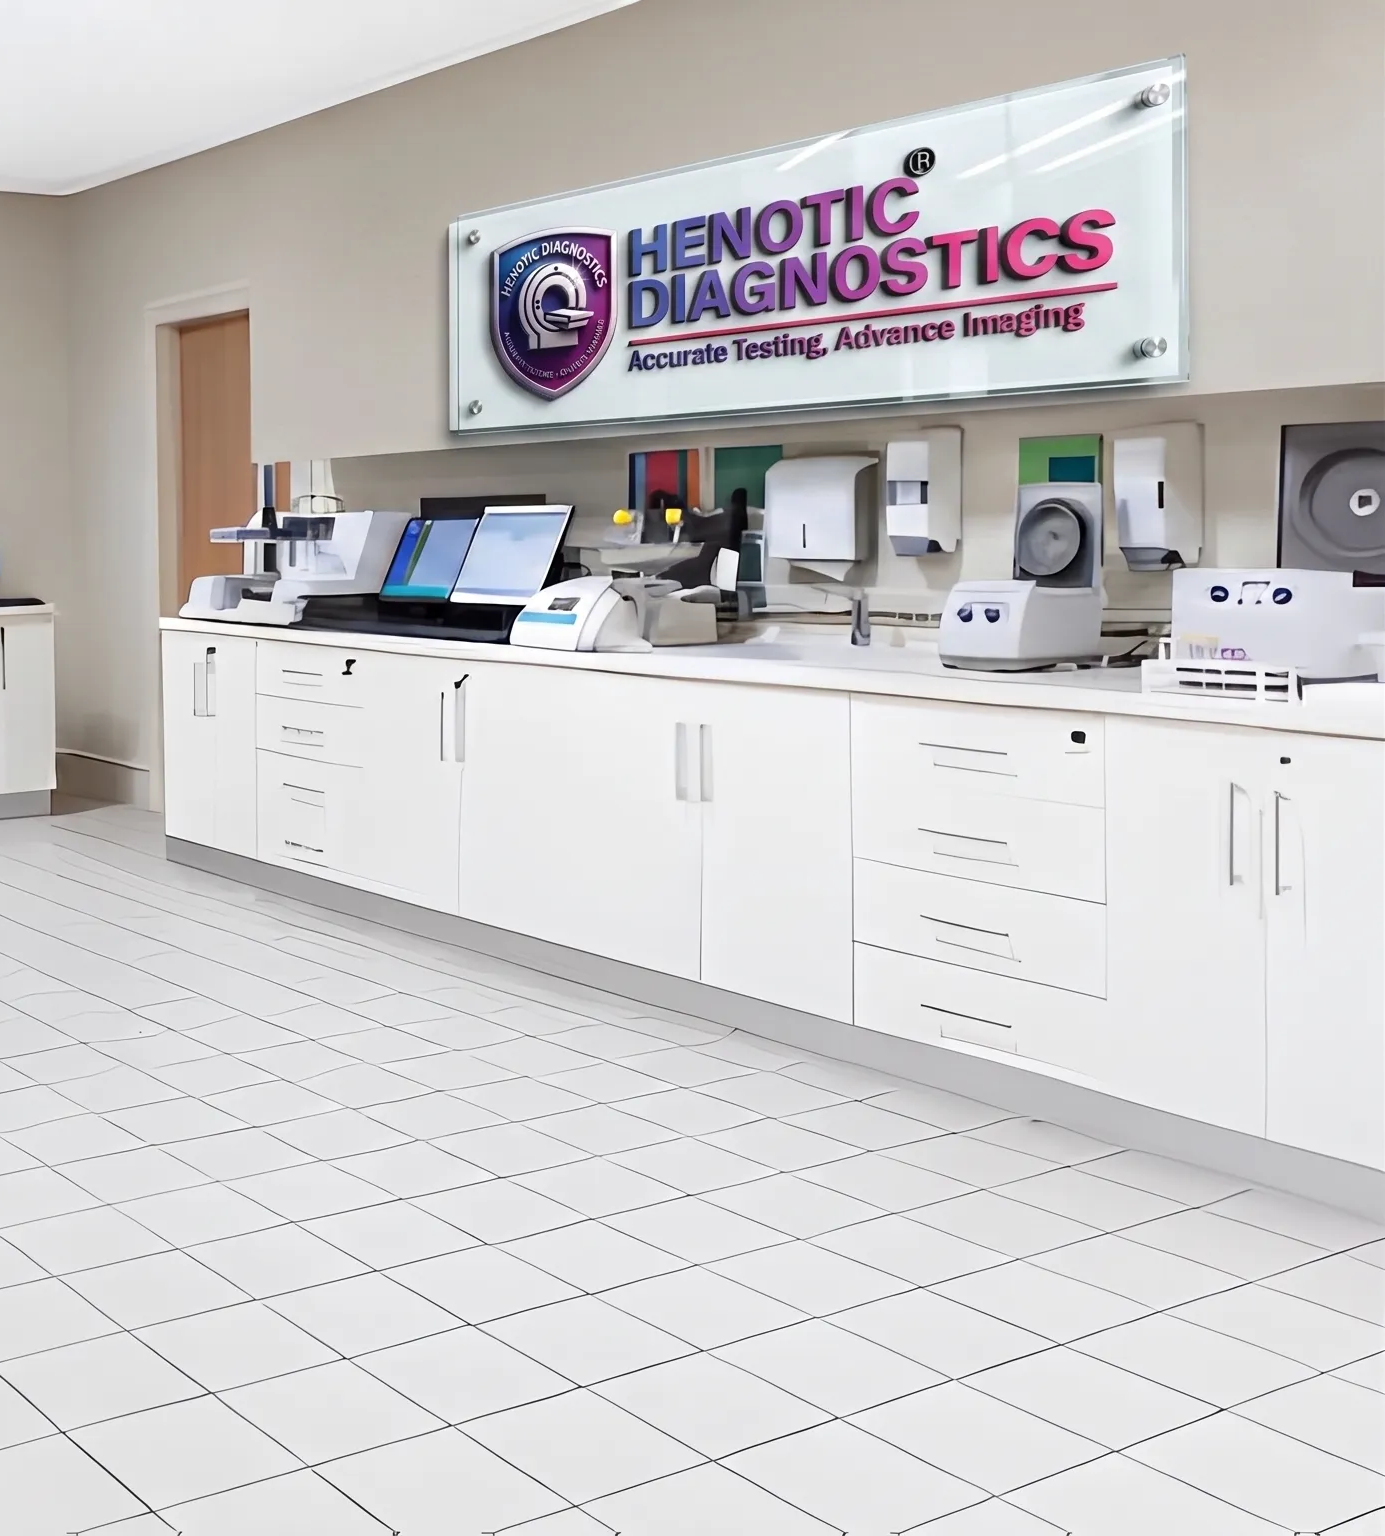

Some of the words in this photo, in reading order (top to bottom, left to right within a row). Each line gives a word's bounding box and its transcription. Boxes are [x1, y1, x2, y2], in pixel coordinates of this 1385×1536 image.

[541, 240, 608, 288] DIAGNOSTICS
[628, 177, 920, 278] HENOTIC
[628, 208, 1117, 330] DIAGNOSTICS
[628, 343, 728, 372] Accurate
[732, 332, 828, 360] Testing,
[833, 319, 956, 352] Advance
[962, 302, 1086, 338] Imaging
